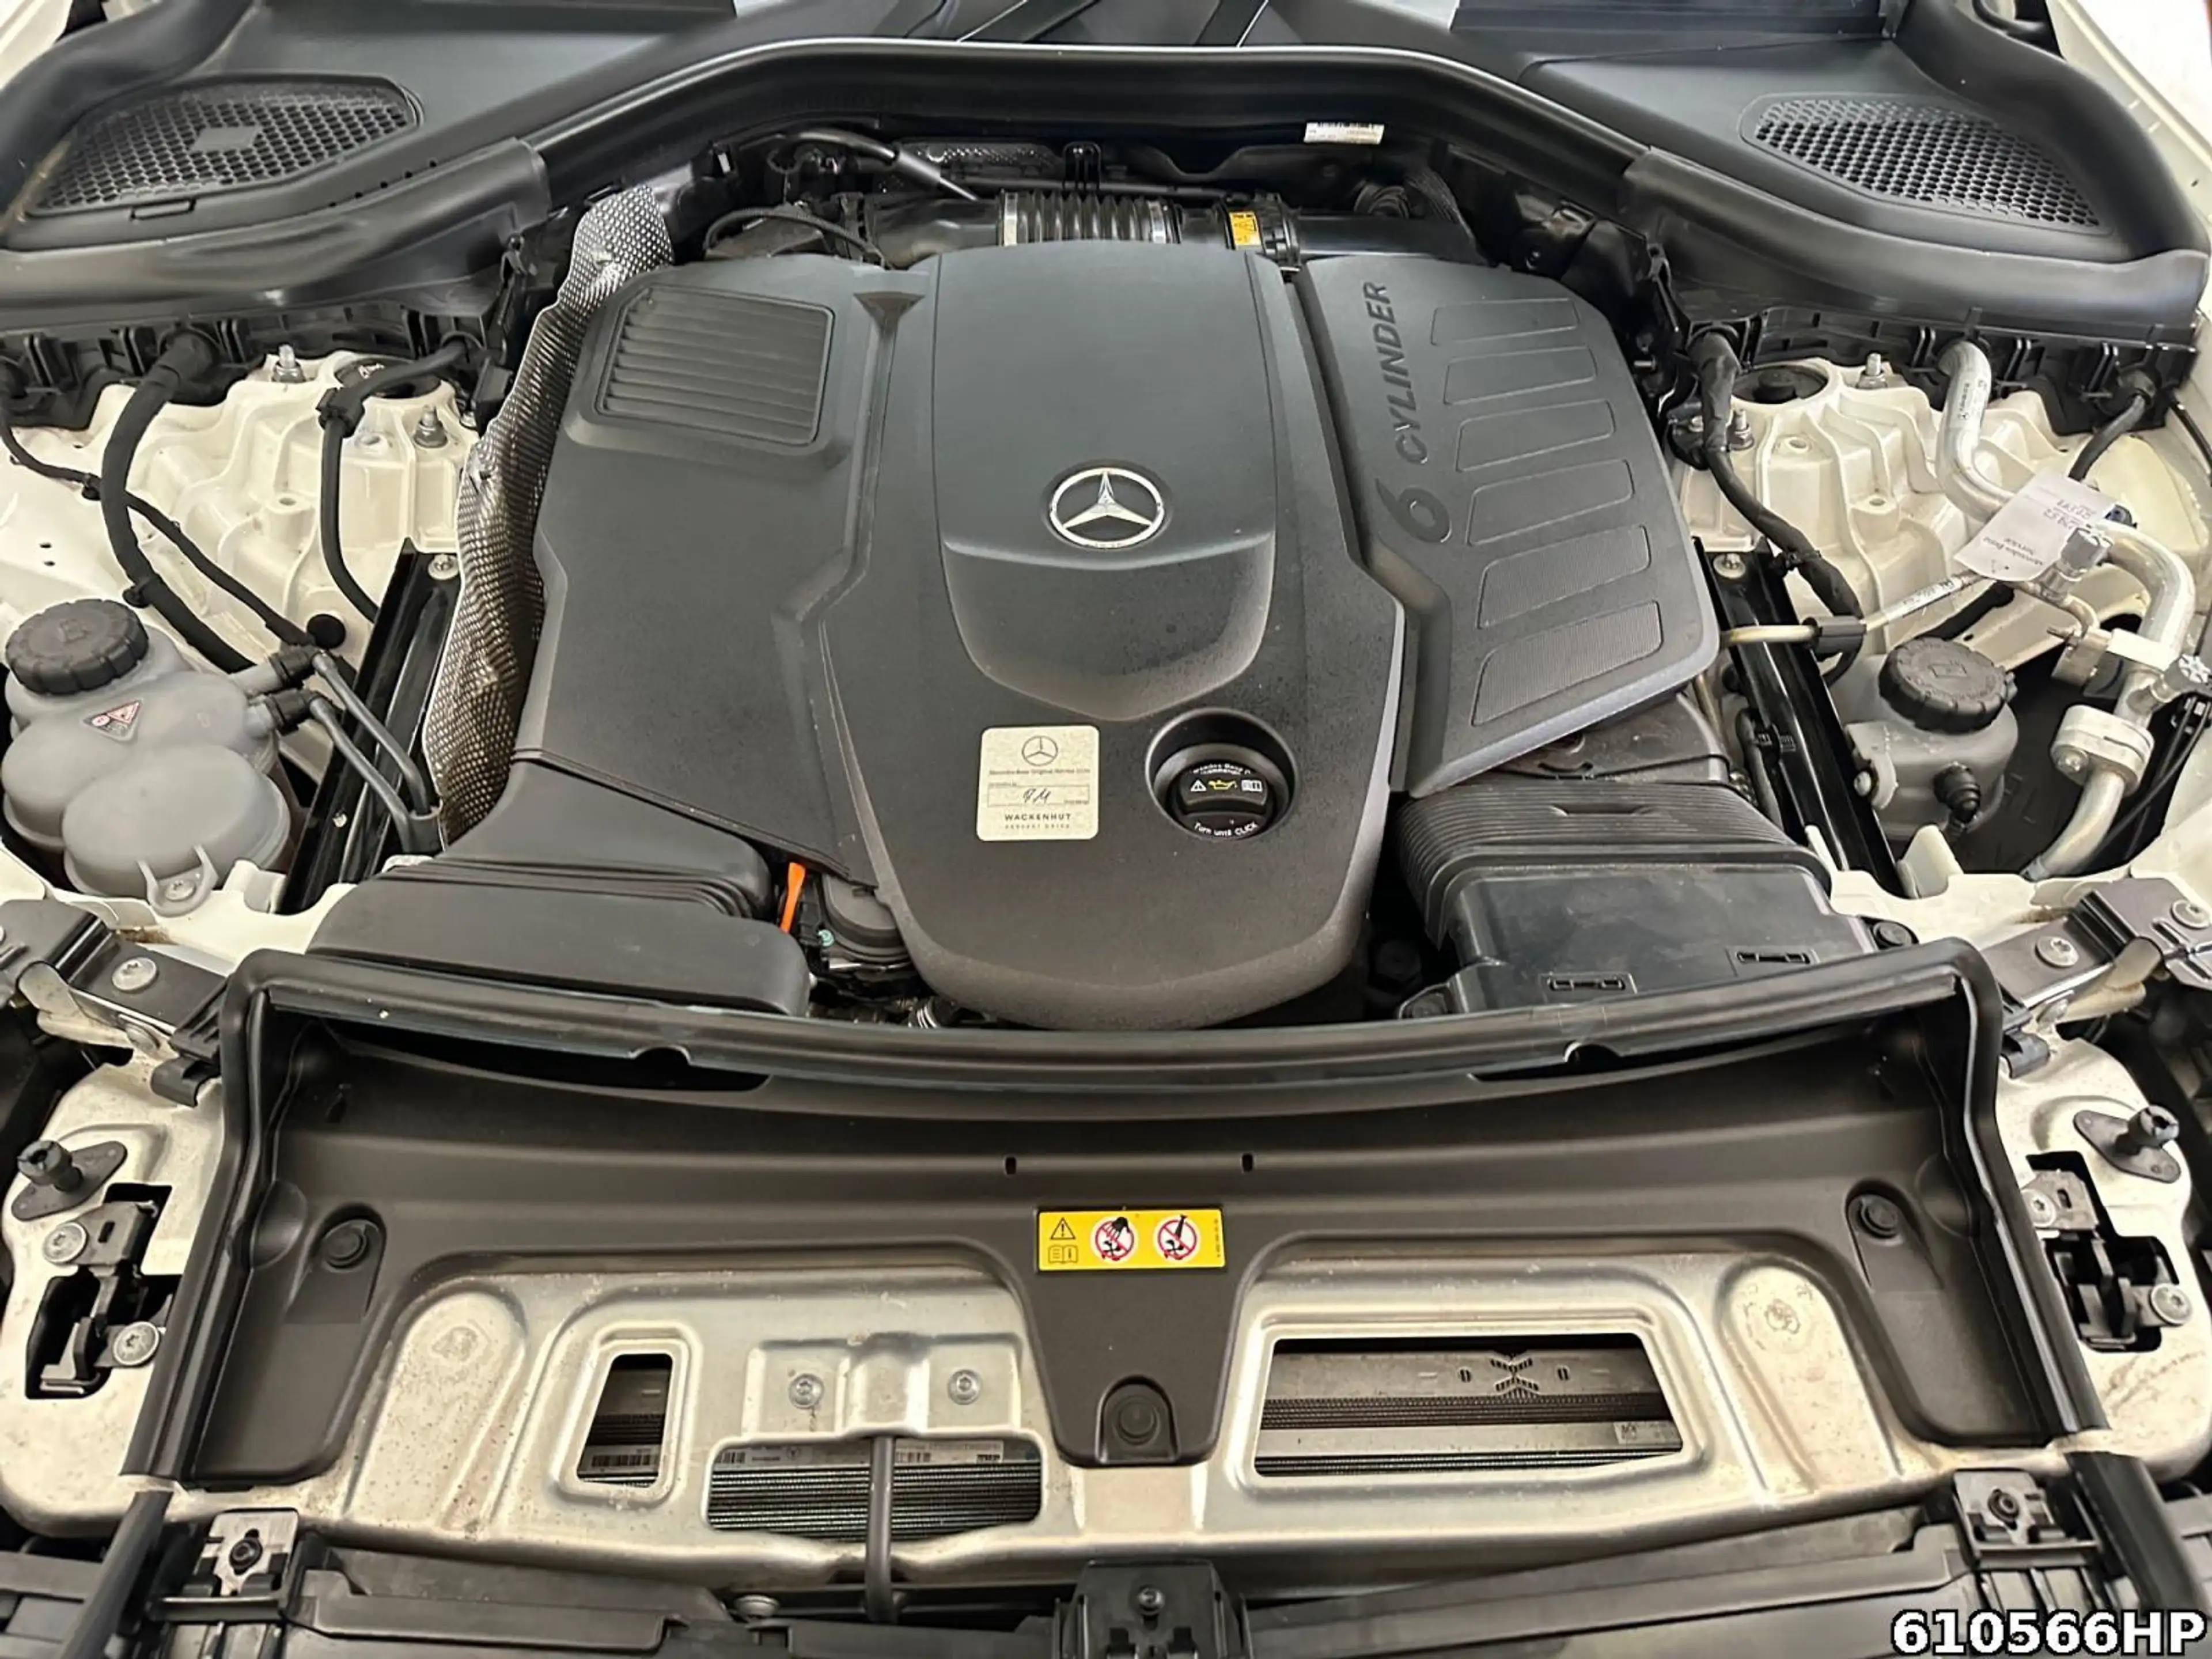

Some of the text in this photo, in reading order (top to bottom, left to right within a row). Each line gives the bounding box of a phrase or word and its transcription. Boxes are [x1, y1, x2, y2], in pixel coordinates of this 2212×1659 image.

[1363, 281, 1452, 543] 6 CYLINDER
[1005, 813, 1071, 821] WACKENHUT
[1234, 821, 1260, 836] CLICK
